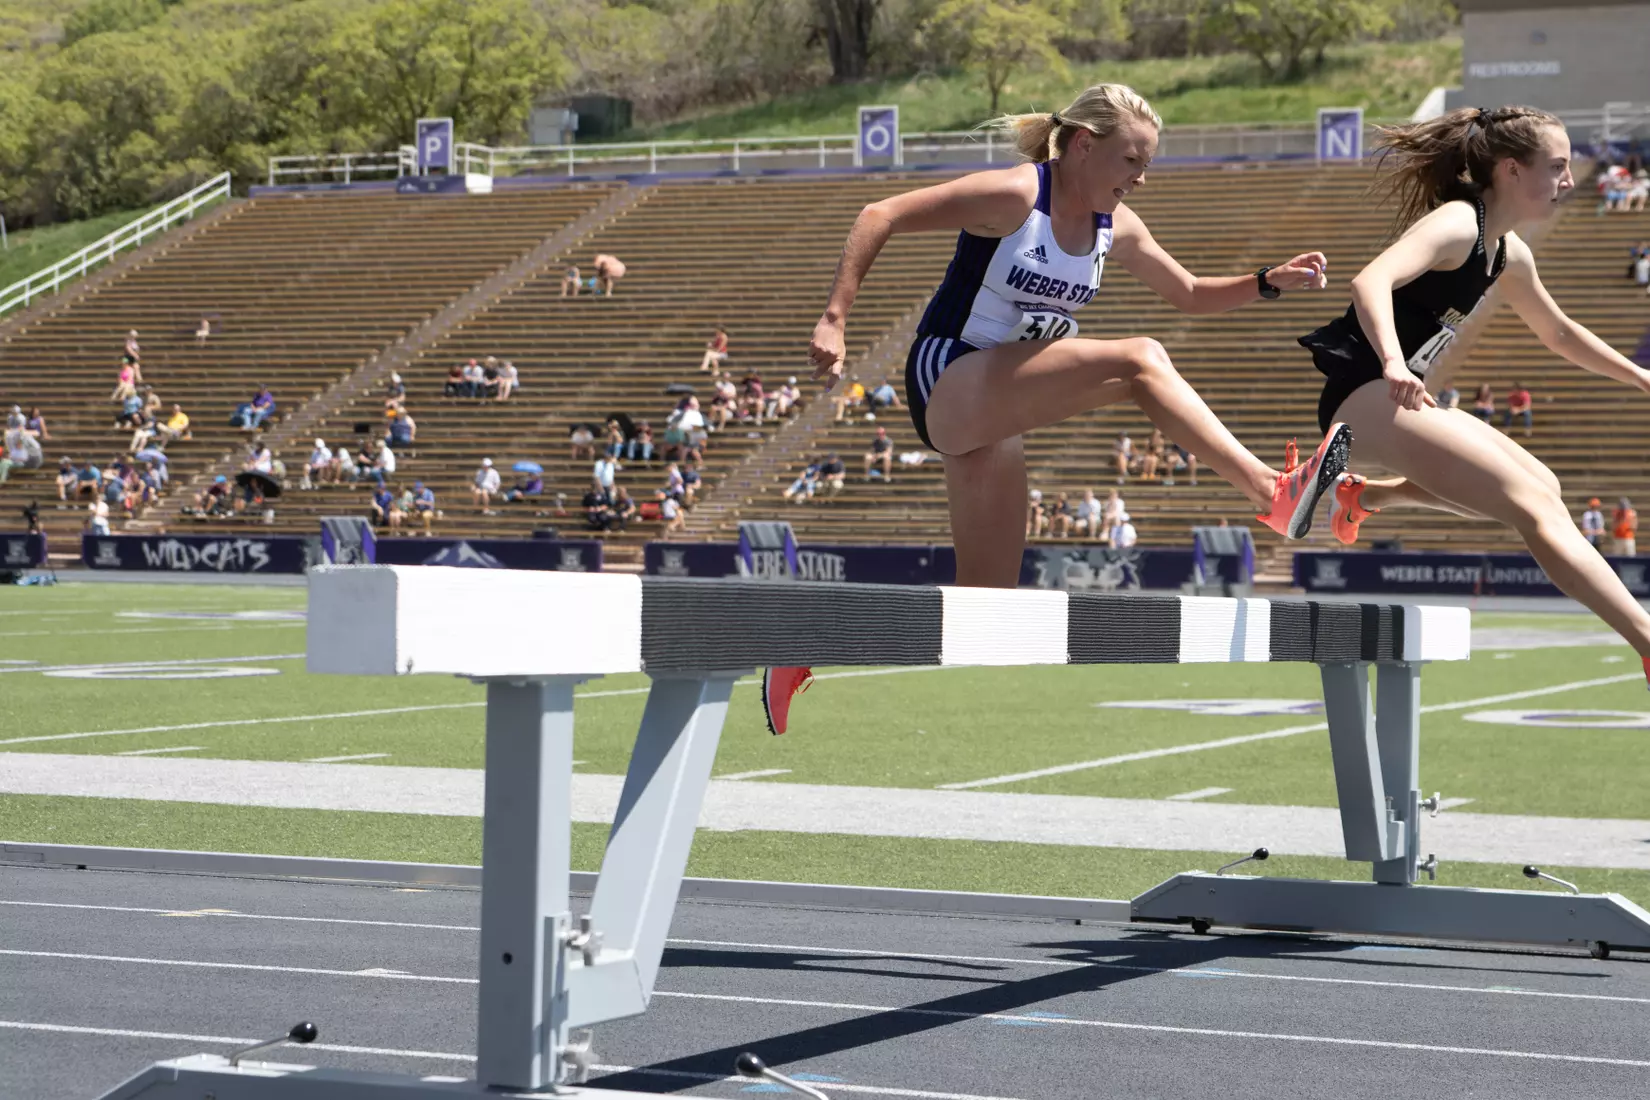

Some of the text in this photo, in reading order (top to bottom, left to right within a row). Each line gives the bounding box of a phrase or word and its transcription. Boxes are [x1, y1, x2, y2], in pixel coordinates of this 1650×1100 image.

[425, 136, 442, 162] P
[865, 125, 890, 151] O
[1327, 127, 1352, 157] N
[1023, 251, 1049, 265] adidas
[1005, 264, 1069, 300] WEBER
[141, 538, 270, 571] WILDCATS
[797, 550, 846, 580] STATE
[1380, 565, 1434, 583] WEBER
[1437, 566, 1481, 583] STATE
